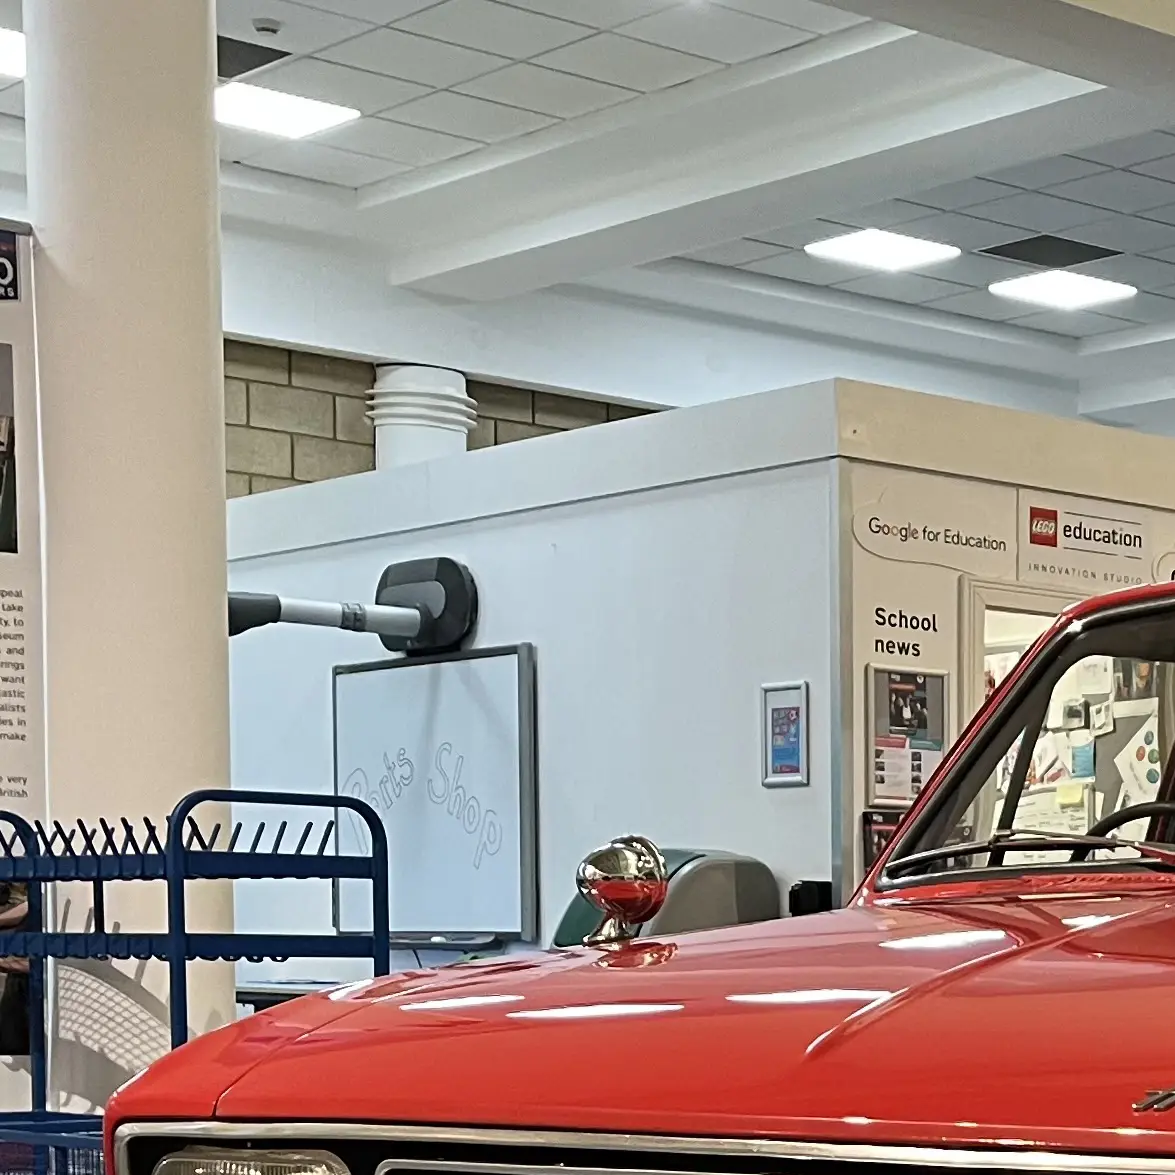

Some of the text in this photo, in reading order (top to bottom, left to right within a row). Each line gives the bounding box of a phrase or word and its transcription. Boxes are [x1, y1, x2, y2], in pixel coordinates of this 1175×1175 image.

[868, 516, 1007, 551] Google for Education
[1032, 519, 1142, 548] LEGO education
[1028, 562, 1142, 585] INNOVATION STUDIO
[875, 607, 938, 632] School
[875, 639, 921, 657] news
[427, 741, 503, 870] Shop
